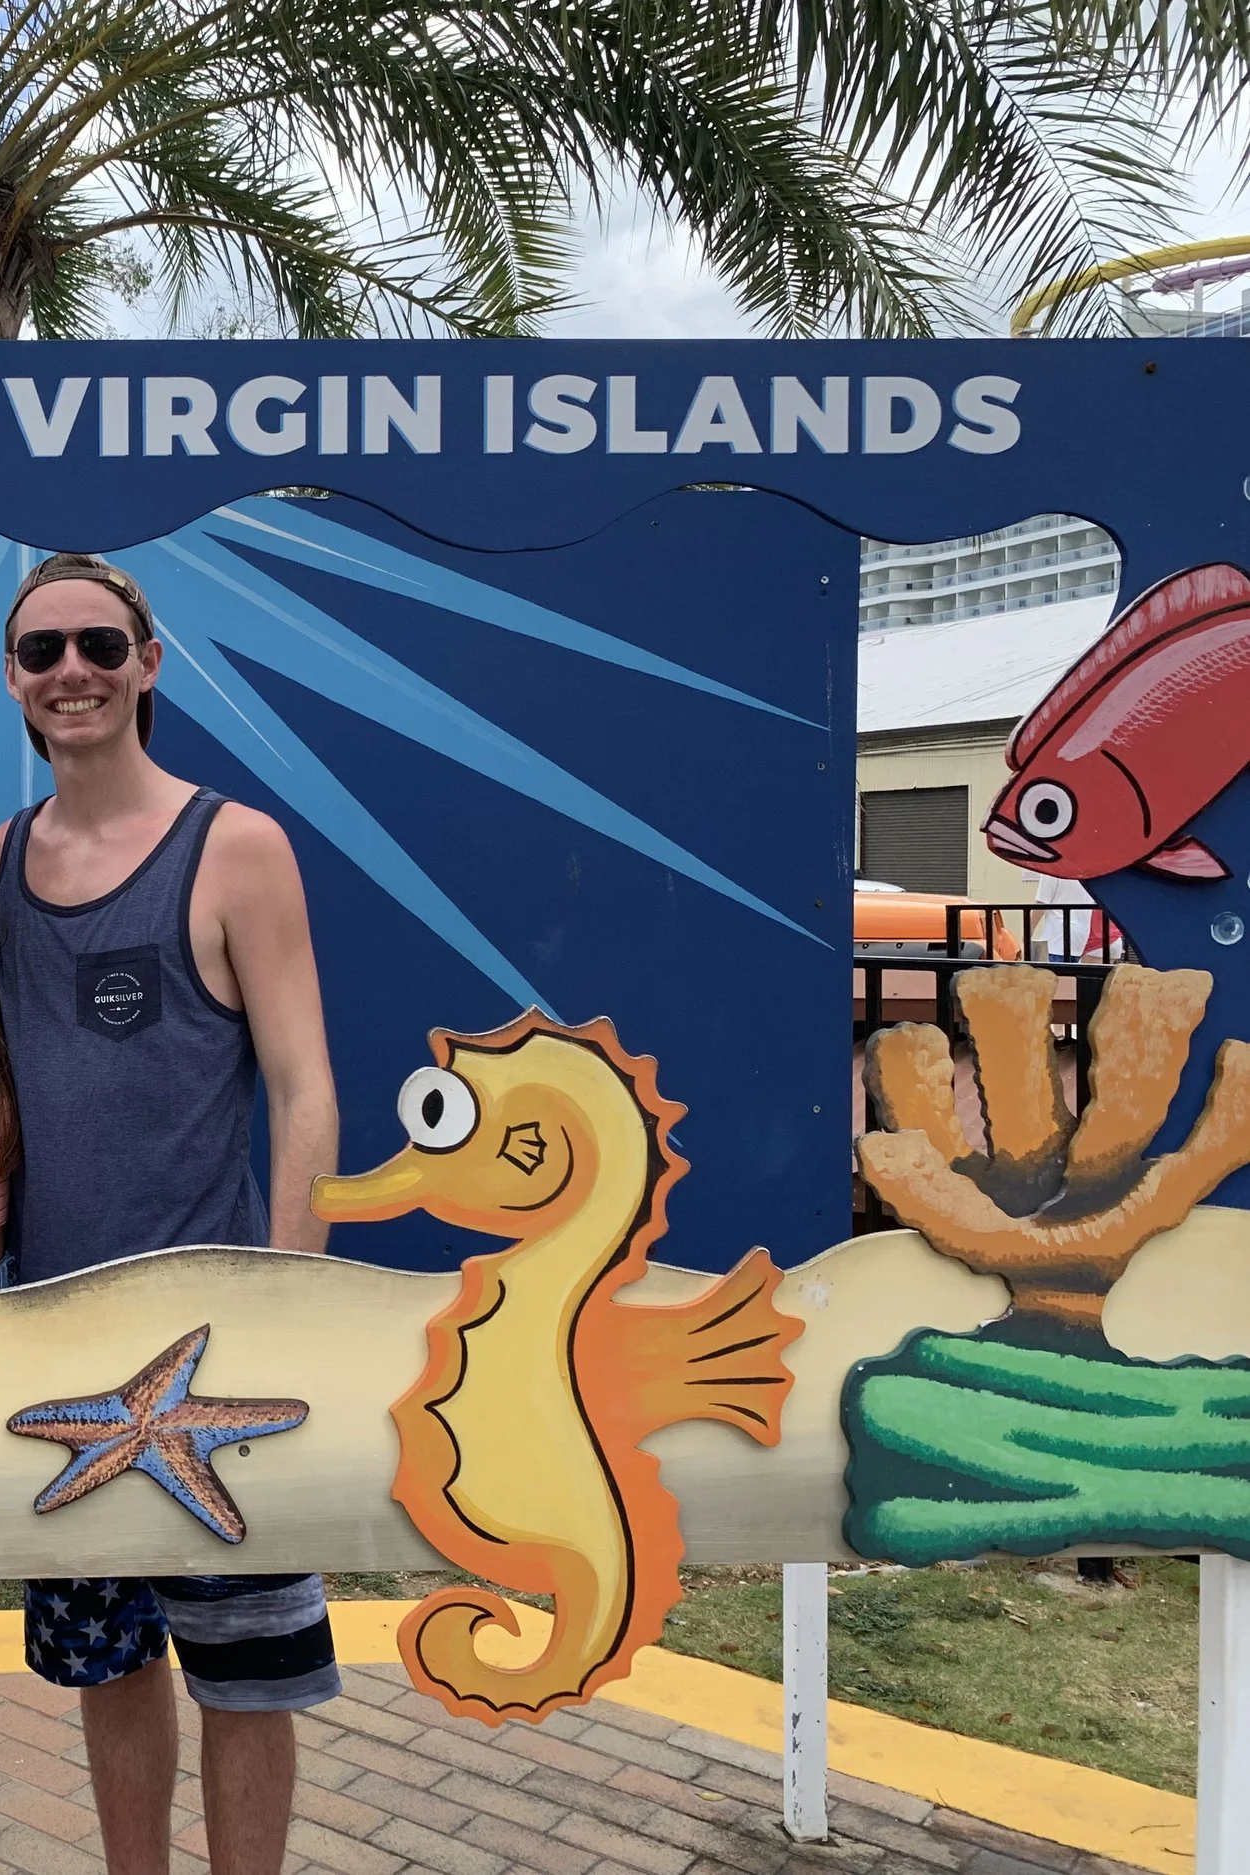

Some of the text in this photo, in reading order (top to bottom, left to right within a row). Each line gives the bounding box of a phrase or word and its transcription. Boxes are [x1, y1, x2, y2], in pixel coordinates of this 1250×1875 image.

[3, 375, 441, 458] VIRGIN
[484, 374, 1022, 455] ISLANDS
[95, 992, 143, 1003] QUIKSILVER
